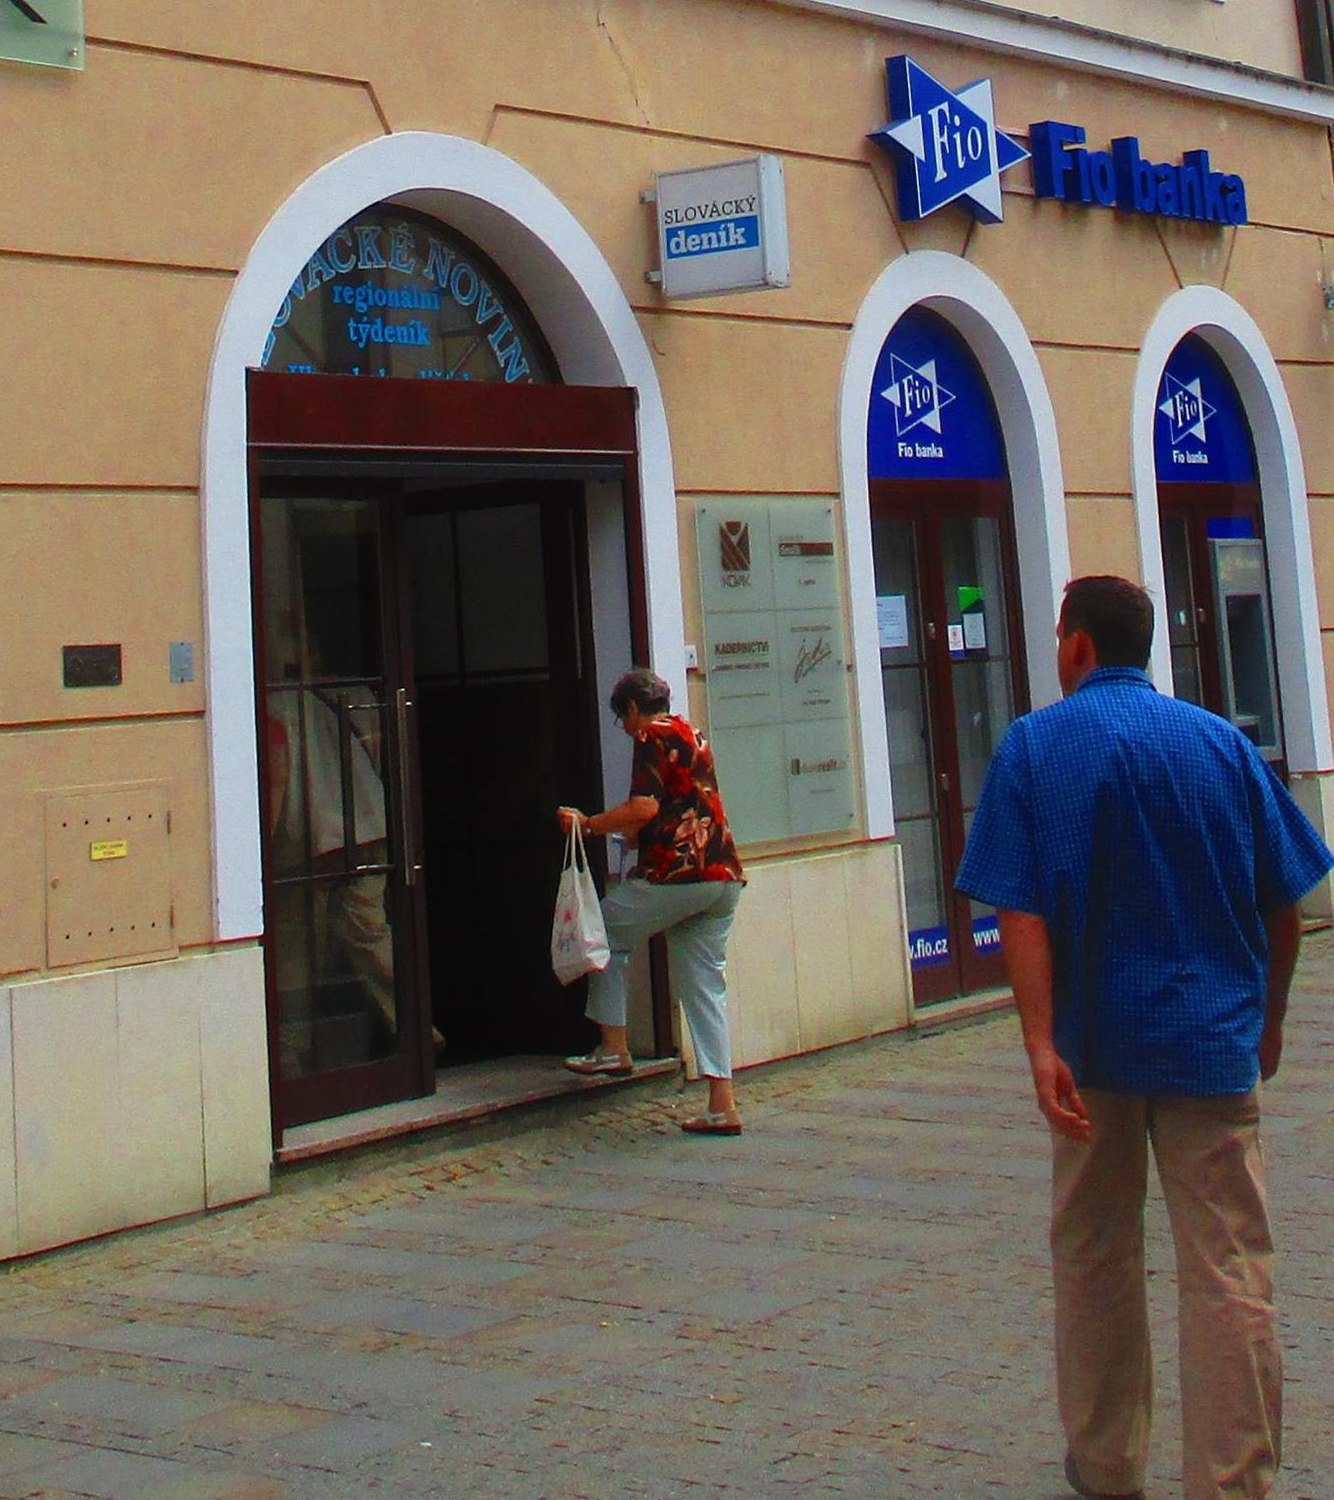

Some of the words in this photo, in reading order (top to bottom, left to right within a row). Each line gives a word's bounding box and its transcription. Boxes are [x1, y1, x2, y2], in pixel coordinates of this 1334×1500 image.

[927, 100, 984, 184] Fio
[1030, 120, 1117, 207] Fio
[1112, 137, 1249, 226] banka
[664, 194, 757, 225] SLOVÁCKÝ
[669, 221, 747, 255] deník
[332, 280, 442, 313] regionální
[423, 236, 534, 384] NOVIN
[347, 316, 432, 348] týdeník
[902, 374, 931, 418] Fio
[1174, 390, 1198, 429] Fio
[897, 442, 914, 458] Fio
[915, 442, 944, 458] banka
[1172, 449, 1186, 464] Fio
[1185, 449, 1209, 465] banka
